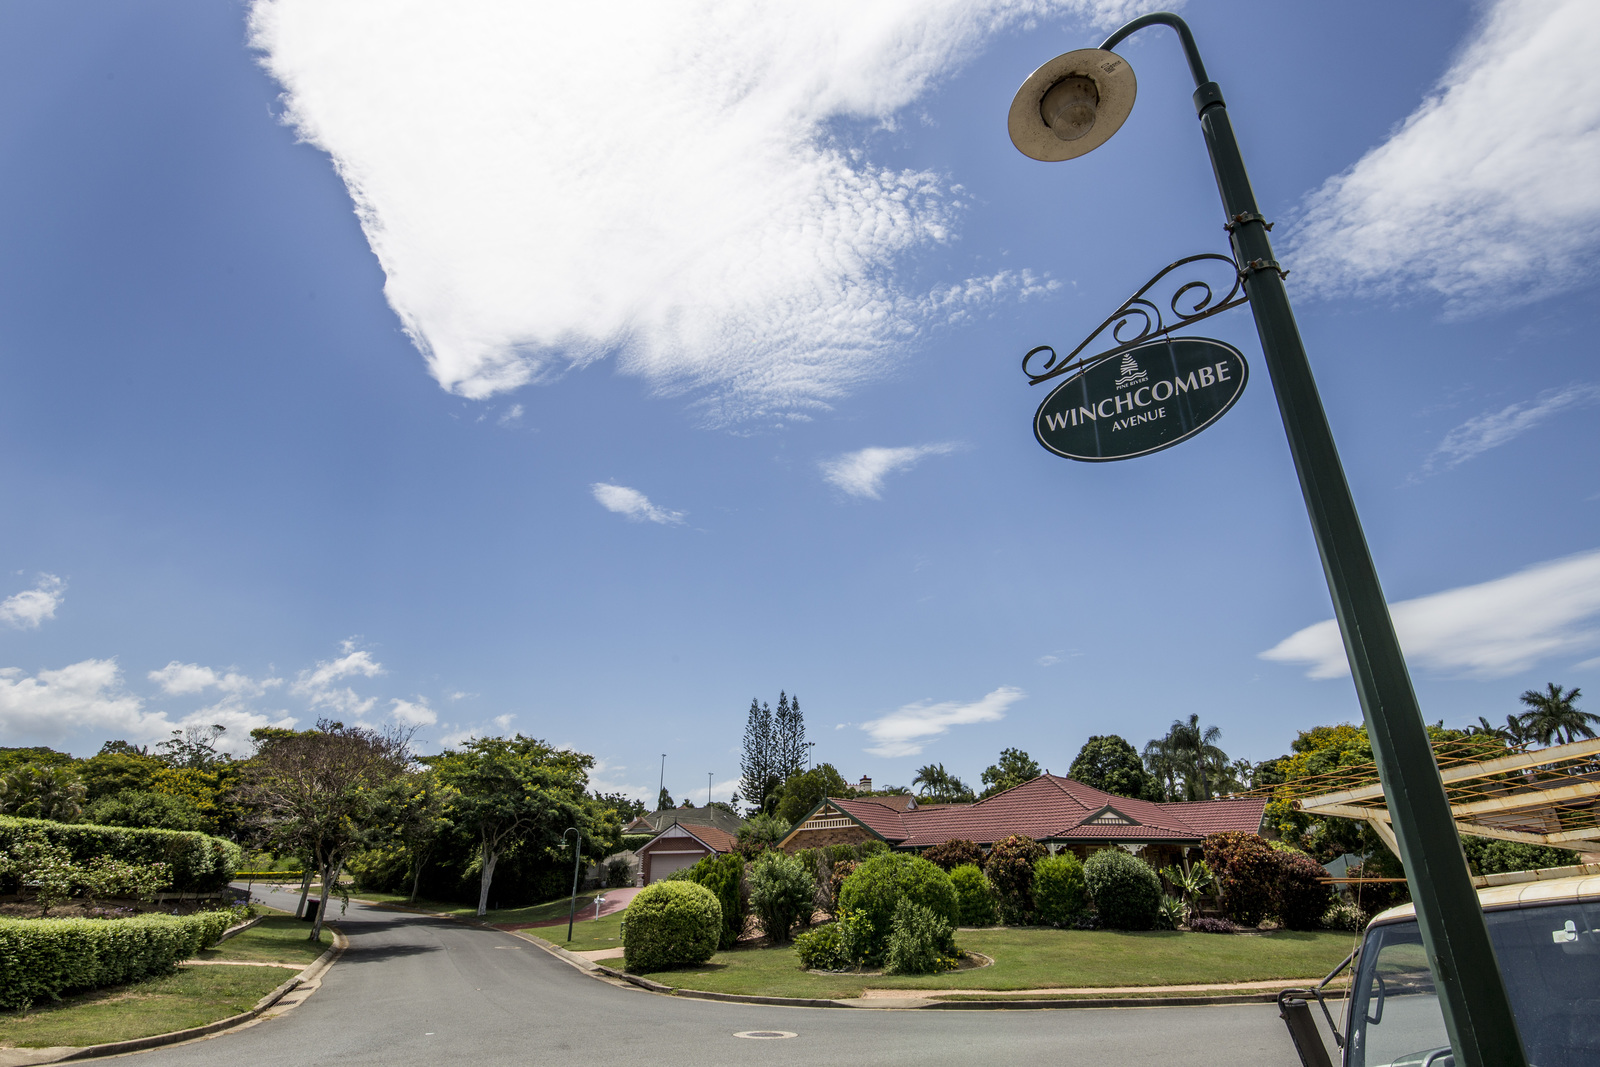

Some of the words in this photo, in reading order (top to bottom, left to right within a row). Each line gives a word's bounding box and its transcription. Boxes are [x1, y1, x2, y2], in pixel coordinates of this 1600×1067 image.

[1045, 360, 1231, 432] WINCHCOMBE
[1116, 383, 1129, 391] PINE
[1130, 376, 1149, 386] RIVERS
[1112, 407, 1166, 432] AVENUE
